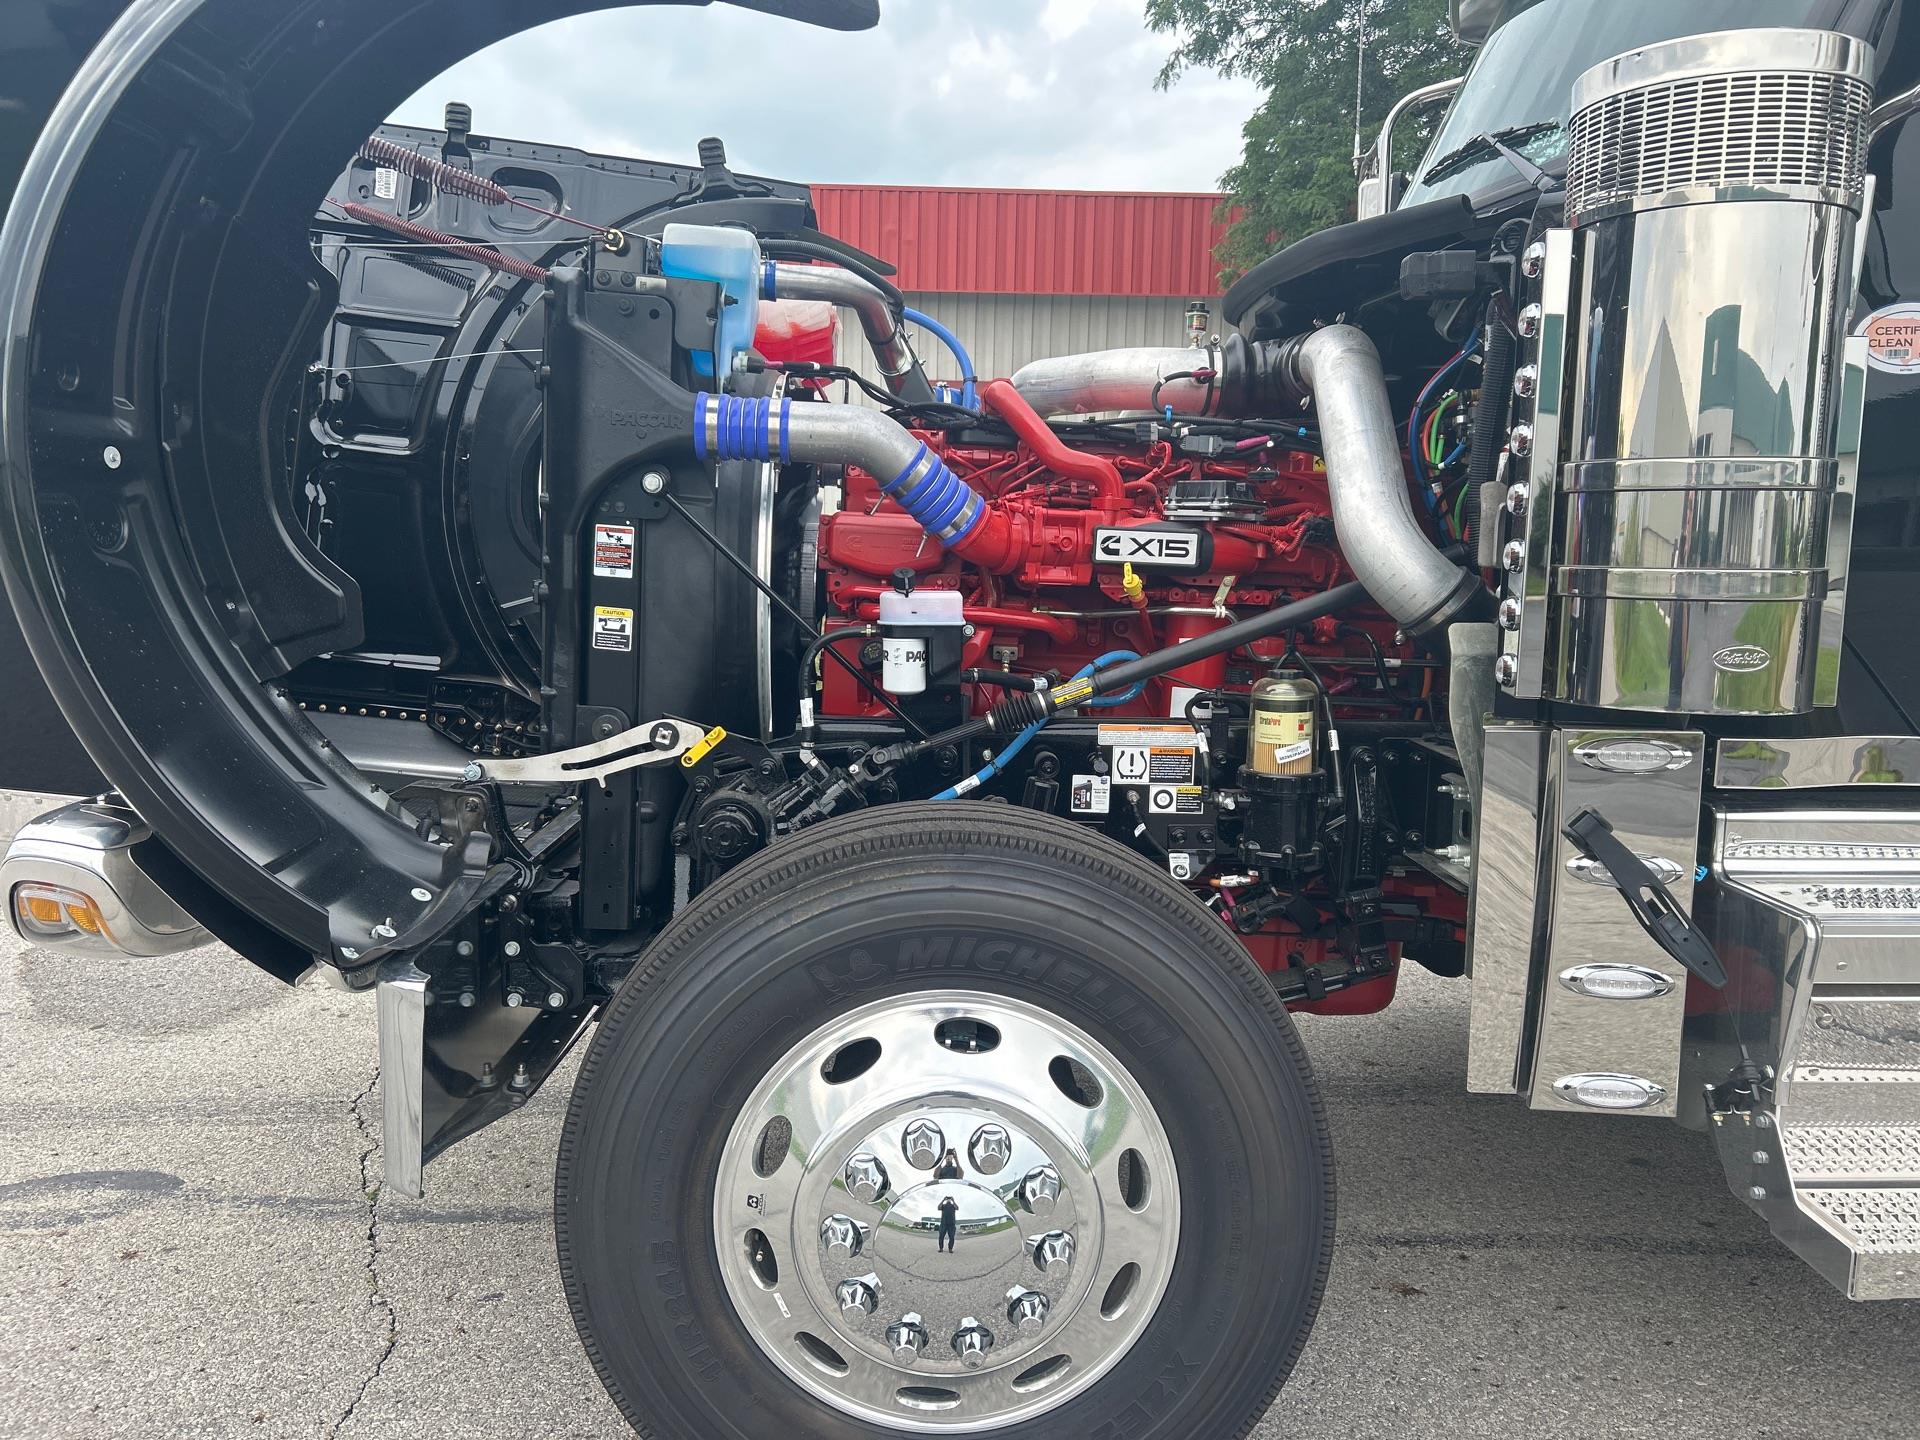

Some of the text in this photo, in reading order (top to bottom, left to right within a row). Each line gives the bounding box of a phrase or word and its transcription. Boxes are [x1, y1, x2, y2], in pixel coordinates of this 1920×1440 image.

[1869, 338, 1913, 348] CLEAN
[609, 408, 684, 430] PACCAR
[1127, 537, 1190, 558] X15
[896, 935, 1173, 1050] MICHELIN
